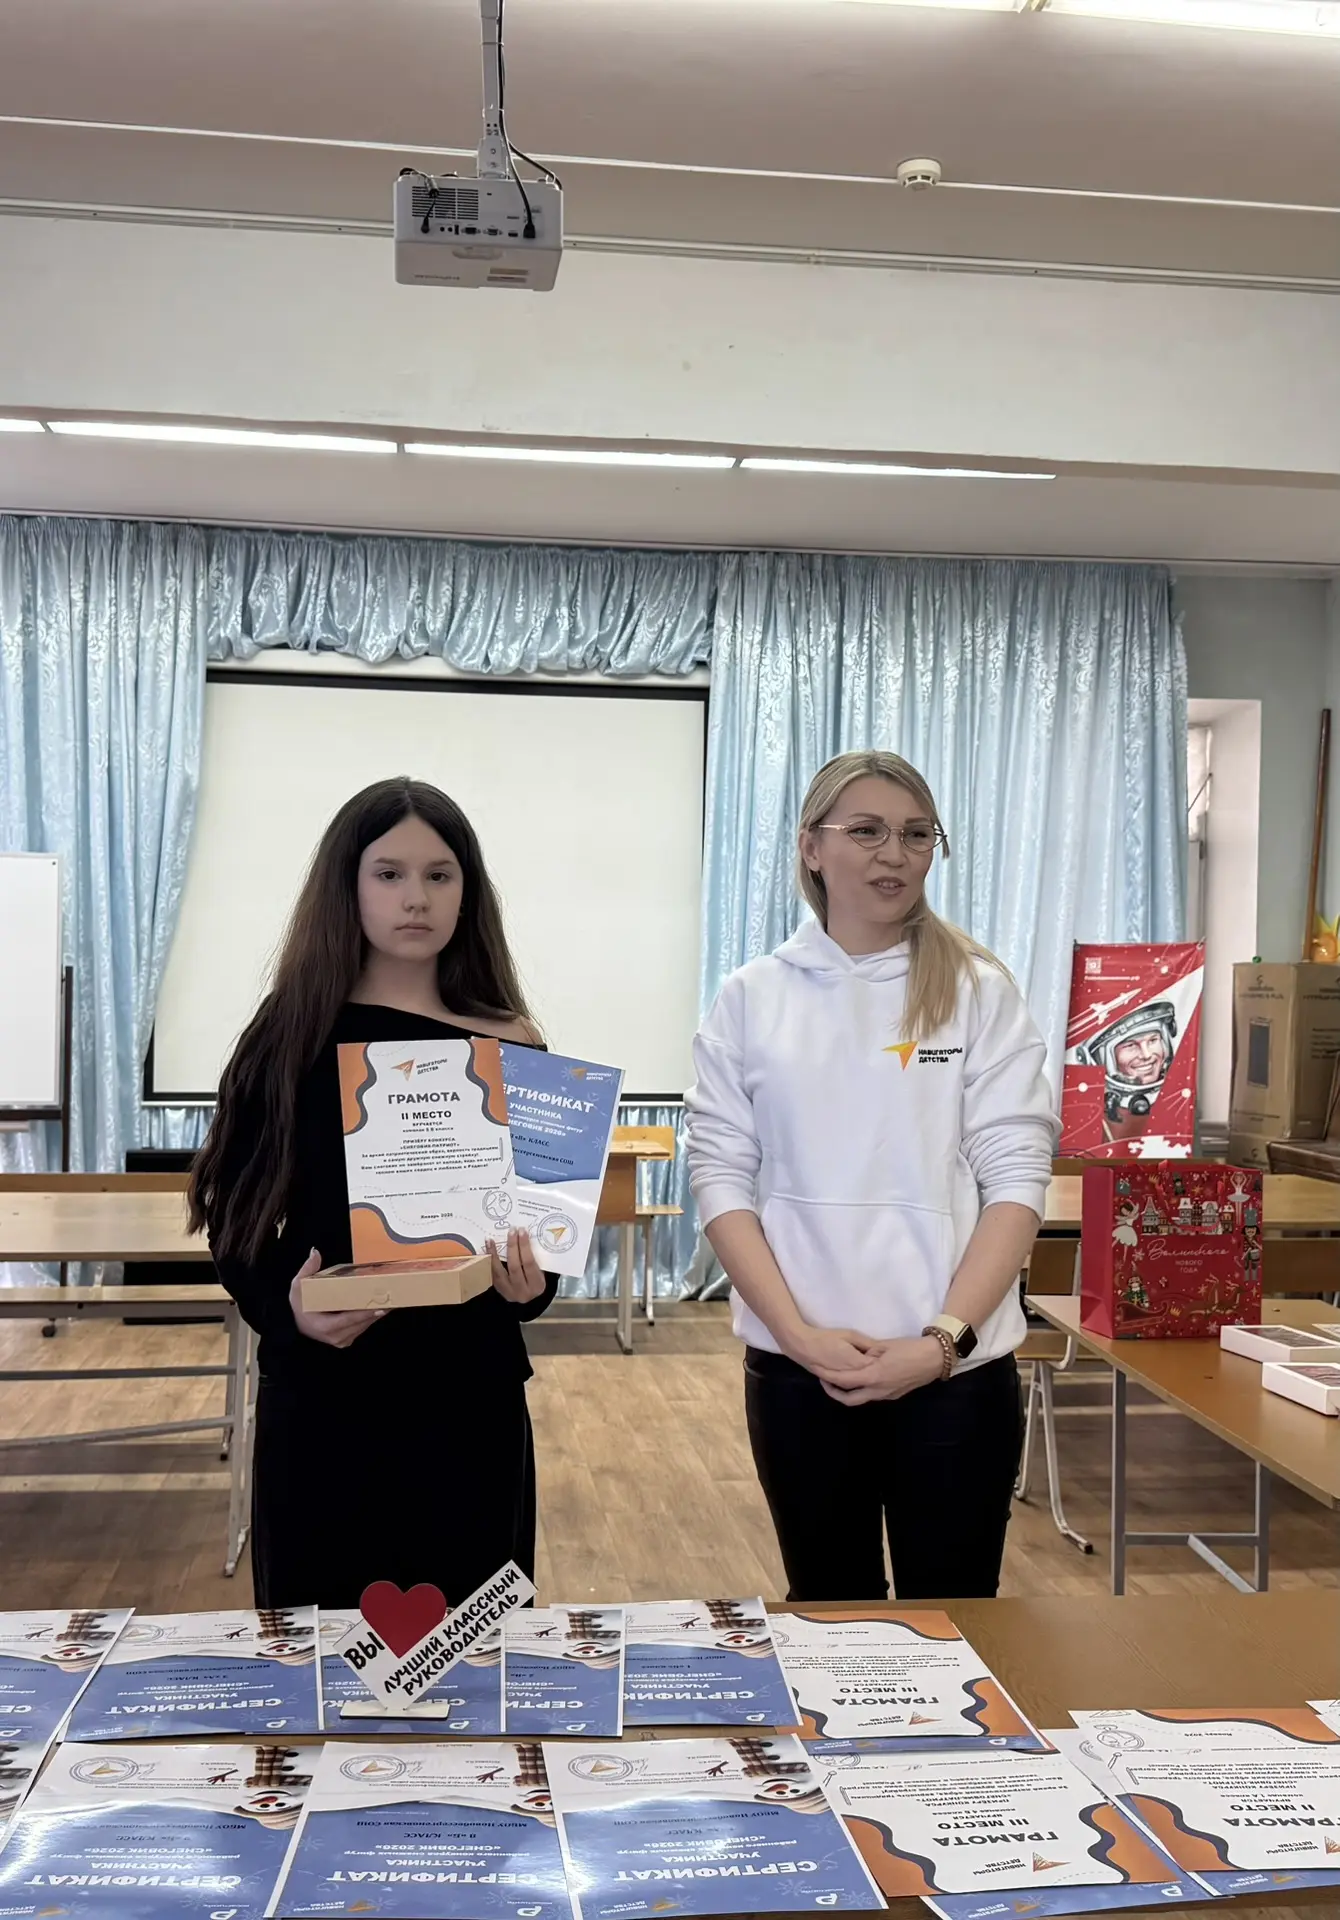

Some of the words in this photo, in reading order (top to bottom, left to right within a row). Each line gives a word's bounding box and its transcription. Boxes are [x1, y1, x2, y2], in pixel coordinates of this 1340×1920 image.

[416, 1066, 439, 1075] ДЕТСТВА
[388, 1092, 461, 1104] ГРАМОТА
[401, 1112, 409, 1120] II
[412, 1111, 452, 1120] МЕСТО
[510, 1102, 562, 1120] УЧАСТНИКА
[528, 1138, 550, 1146] КЛАСС
[559, 1156, 574, 1166] СОШ
[384, 1635, 444, 1693] ЛУЧШИЙ
[443, 1568, 520, 1639] КЛАССНЫЙ
[403, 1593, 518, 1696] РУКОВОДИТЕЛЬ
[343, 1632, 385, 1670] ВЫ
[153, 1692, 238, 1700] УЧАСТНИКА
[830, 1696, 939, 1705] ГРАМОТА
[105, 1697, 282, 1714] СЕРТИФИКАТ
[937, 1819, 1004, 1830] МЕСТО
[1009, 1818, 1029, 1826] III
[932, 1831, 1059, 1847] ГРАМОТА
[1277, 1841, 1313, 1849] ДЕТСТВА
[660, 1851, 761, 1863] УЧАСТНИКА
[90, 1861, 195, 1869] УЧАСТНИКА
[385, 1859, 486, 1867] УЧАСТНИКА
[984, 1858, 1021, 1868] ДЕТСТВА
[612, 1860, 817, 1882] СЕРТИФИКАТ
[23, 1873, 241, 1886] СЕРТИФИКАТ
[325, 1871, 538, 1884] СЕРТИФИКАТ
